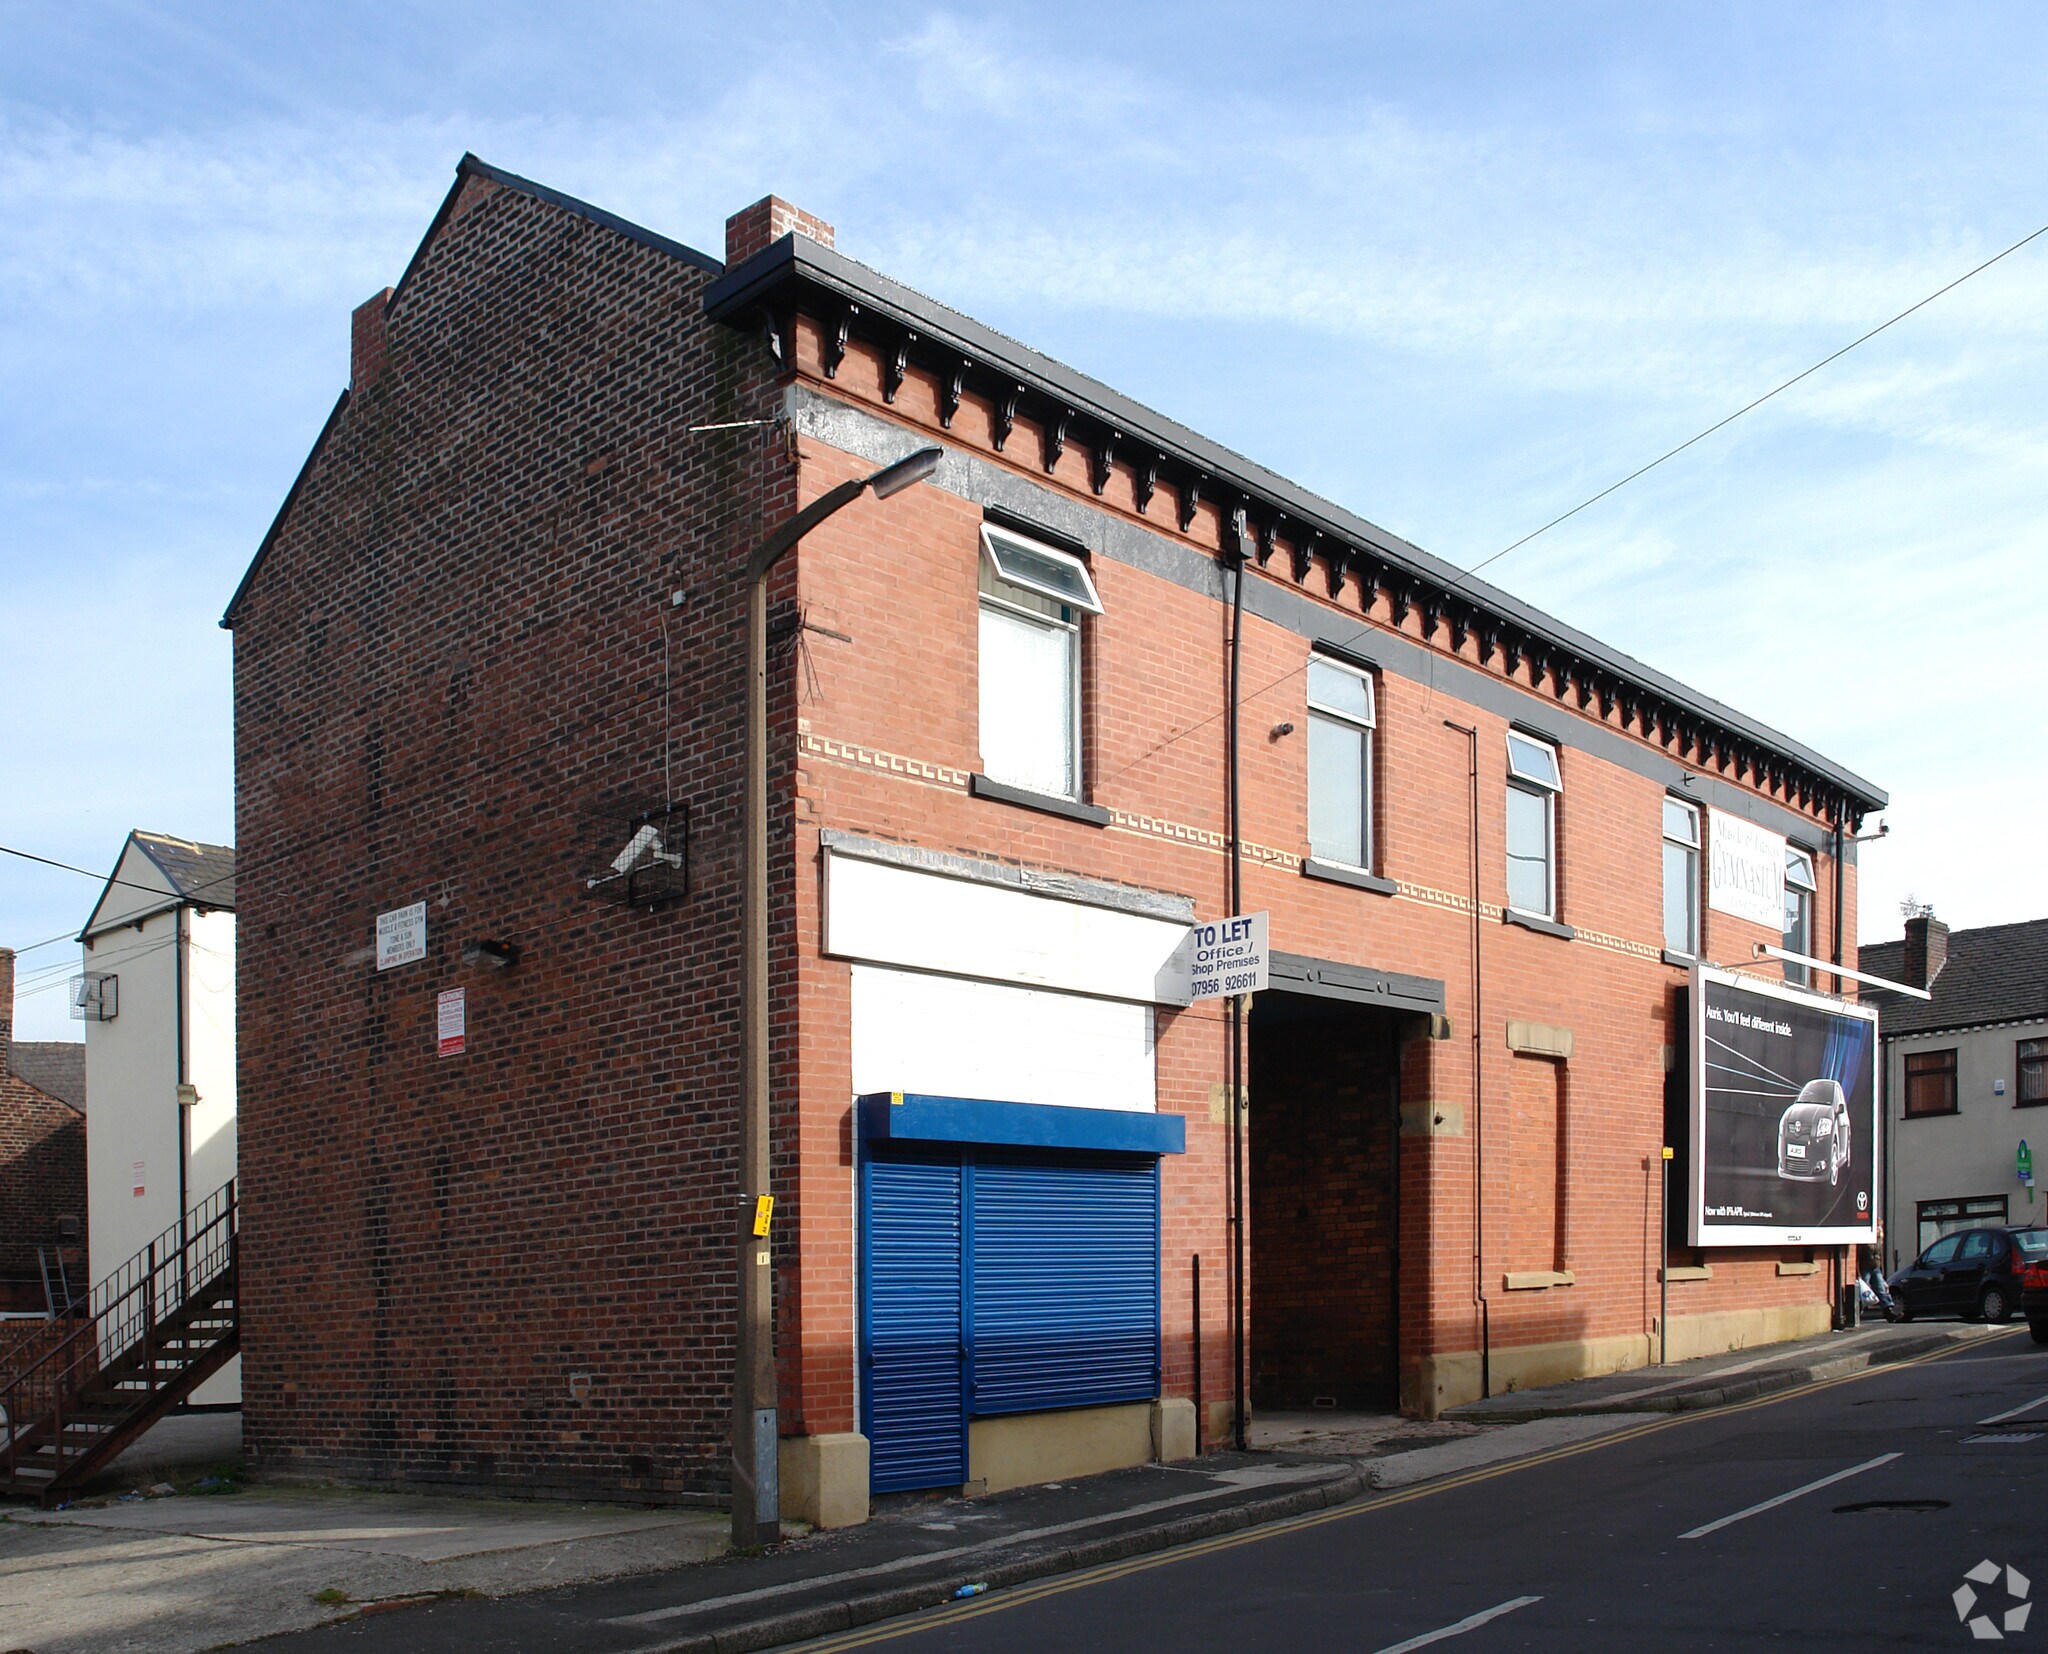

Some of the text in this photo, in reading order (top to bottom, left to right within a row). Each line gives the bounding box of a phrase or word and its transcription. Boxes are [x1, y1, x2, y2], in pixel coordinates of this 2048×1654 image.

[1713, 840, 1782, 910] GYMNASIUM
[389, 912, 397, 922] CAR
[398, 910, 408, 920] PARK
[415, 904, 423, 914] FOR
[379, 924, 393, 935] MUSCLE
[398, 918, 414, 930] FITNESS
[415, 915, 424, 925] GYM
[1194, 918, 1252, 948] TO LET
[380, 954, 398, 966] CLAMPING
[403, 947, 423, 960] OPERATION
[387, 940, 415, 954] MEMBERS ONLY
[1197, 941, 1253, 962] Office /
[1216, 955, 1260, 971] Premises
[1192, 971, 1256, 997] 07956 926611
[1706, 1005, 1793, 1037] Auris. You'll feel different inside.
